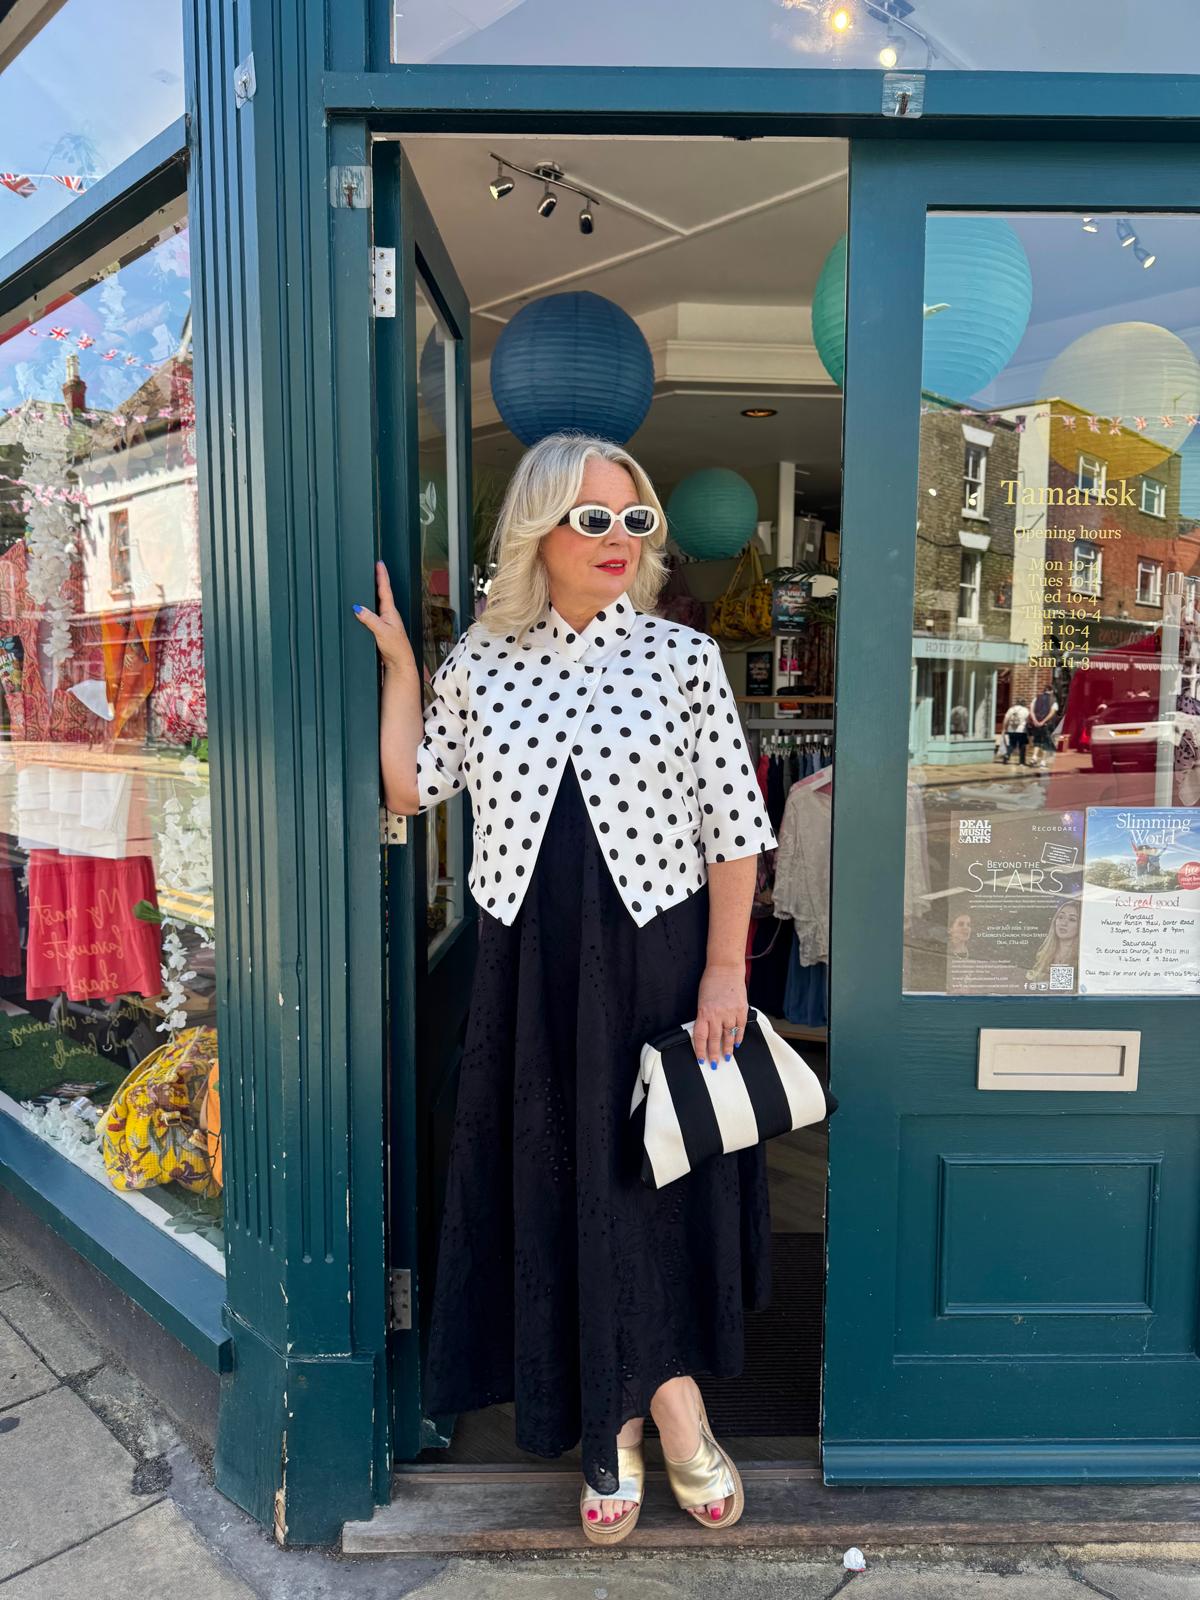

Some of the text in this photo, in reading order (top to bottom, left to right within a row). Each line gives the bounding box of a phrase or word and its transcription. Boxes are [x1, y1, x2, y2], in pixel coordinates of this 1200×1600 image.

[1000, 479, 1136, 507] Tamarisk
[1013, 525, 1122, 543] Opening hours
[1030, 558, 1100, 574] Mon 10-4
[1028, 573, 1099, 590] Tues 10-4
[1029, 589, 1098, 607] Wed 10-4
[1023, 605, 1102, 623] Thurs 10-4
[1033, 621, 1091, 638] Fri 10-4
[1031, 639, 1090, 654] Sat 10-4
[1029, 655, 1090, 671] Sun 11-3
[959, 819, 992, 829] DEAL
[1116, 813, 1191, 833] Slimming
[959, 828, 992, 837] MUSIC
[1131, 829, 1176, 845] World
[987, 860, 1041, 869] BEYOND THE
[967, 864, 1063, 893] STARS
[1115, 895, 1131, 907] feel
[1156, 896, 1180, 908] good
[1123, 912, 1154, 920] Mondays
[1122, 939, 1157, 950] Saturdays
